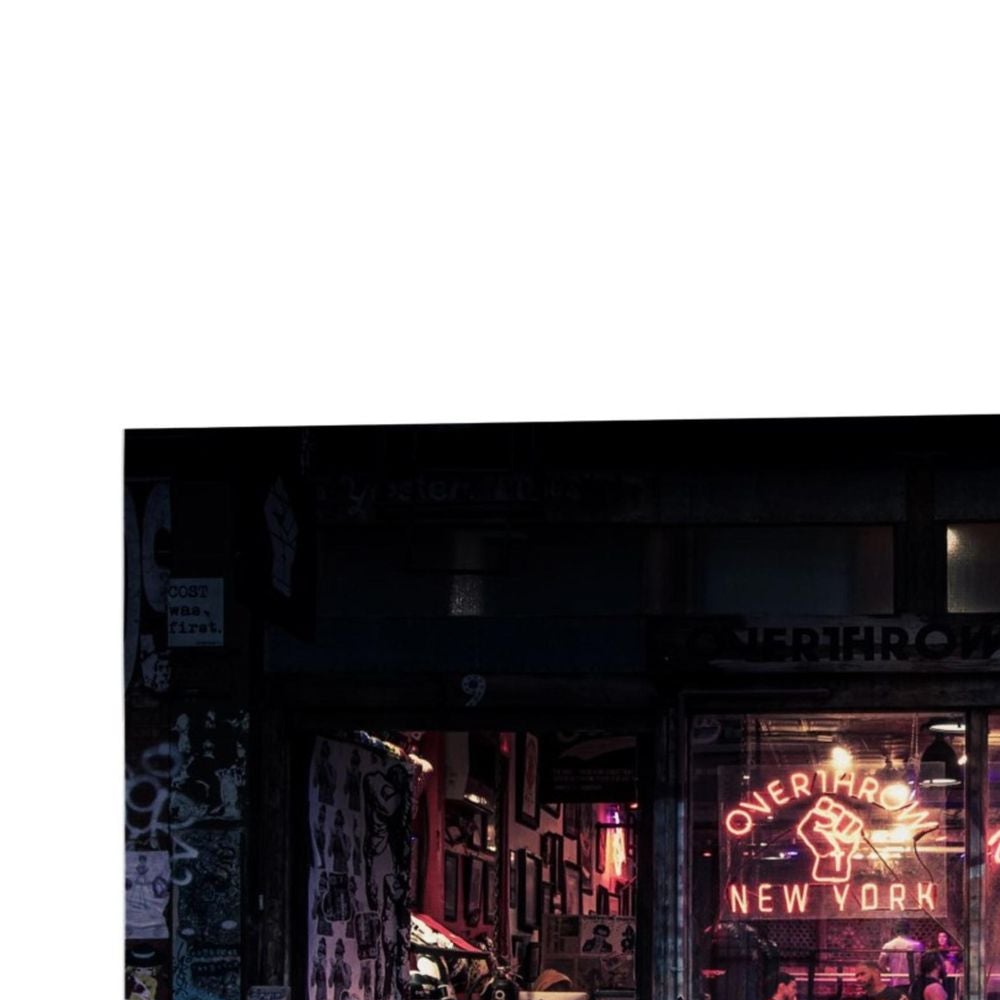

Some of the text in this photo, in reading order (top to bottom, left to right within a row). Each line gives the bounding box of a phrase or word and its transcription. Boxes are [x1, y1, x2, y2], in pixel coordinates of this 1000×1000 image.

[167, 585, 208, 598] COST
[461, 673, 487, 708] 9
[725, 769, 940, 835] OVERTHROW
[730, 882, 935, 914] NEW YORK
